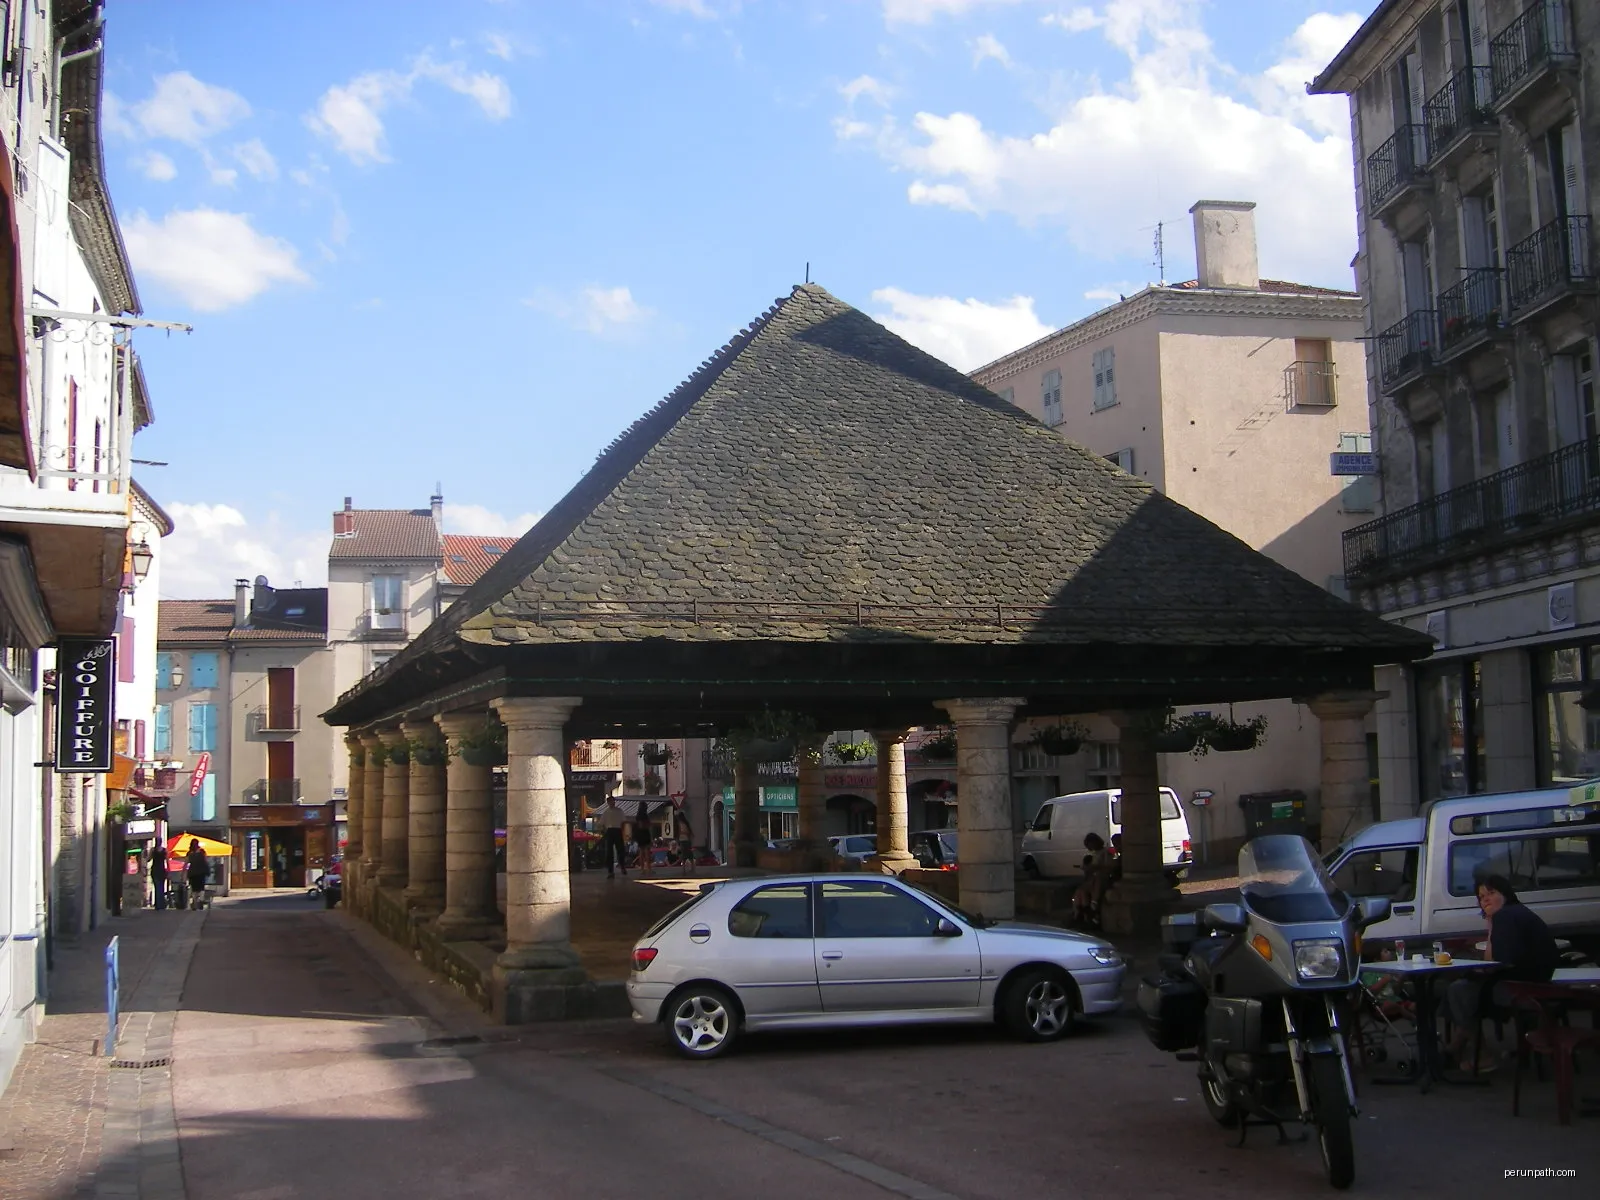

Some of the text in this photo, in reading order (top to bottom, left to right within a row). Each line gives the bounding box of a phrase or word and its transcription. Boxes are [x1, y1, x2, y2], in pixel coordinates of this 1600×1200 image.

[1338, 455, 1373, 465] AGENCE
[74, 660, 98, 763] COIFFURE
[191, 754, 209, 795] TABAC
[766, 792, 794, 801] OPTICIENS
